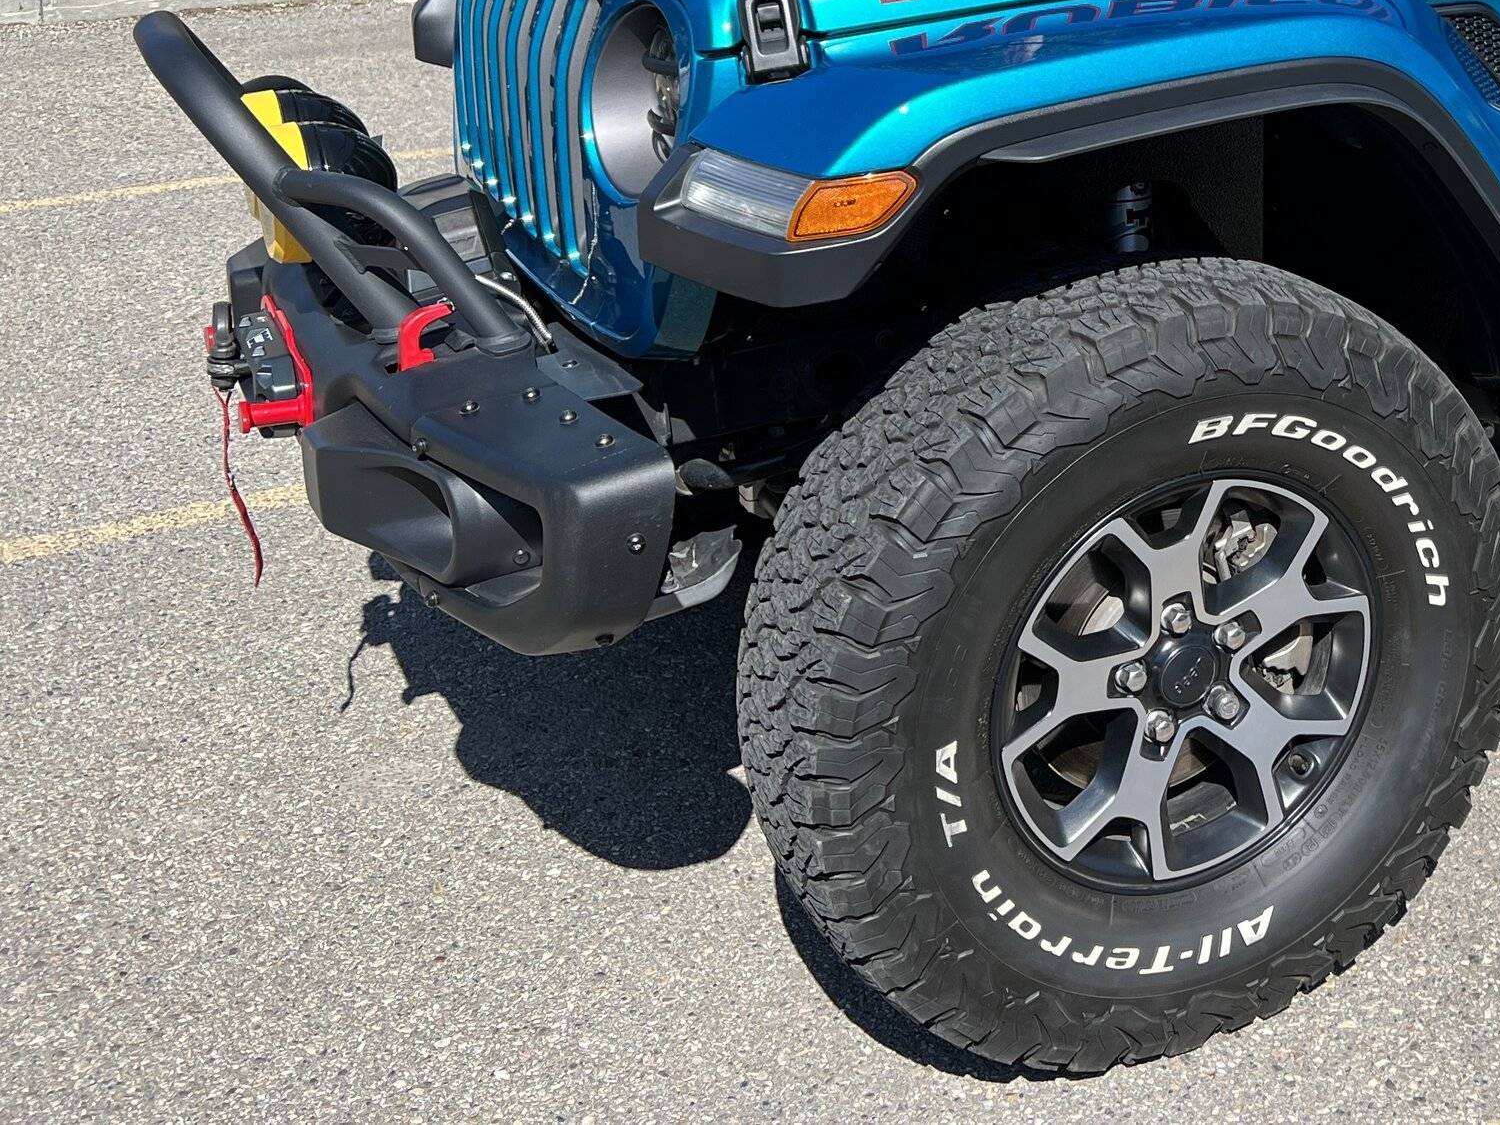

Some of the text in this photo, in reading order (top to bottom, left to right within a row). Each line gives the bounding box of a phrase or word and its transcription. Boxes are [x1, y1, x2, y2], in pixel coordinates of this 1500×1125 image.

[1187, 413, 1450, 606] BFGoodrich
[935, 740, 1274, 975] All-Terrain T/A
